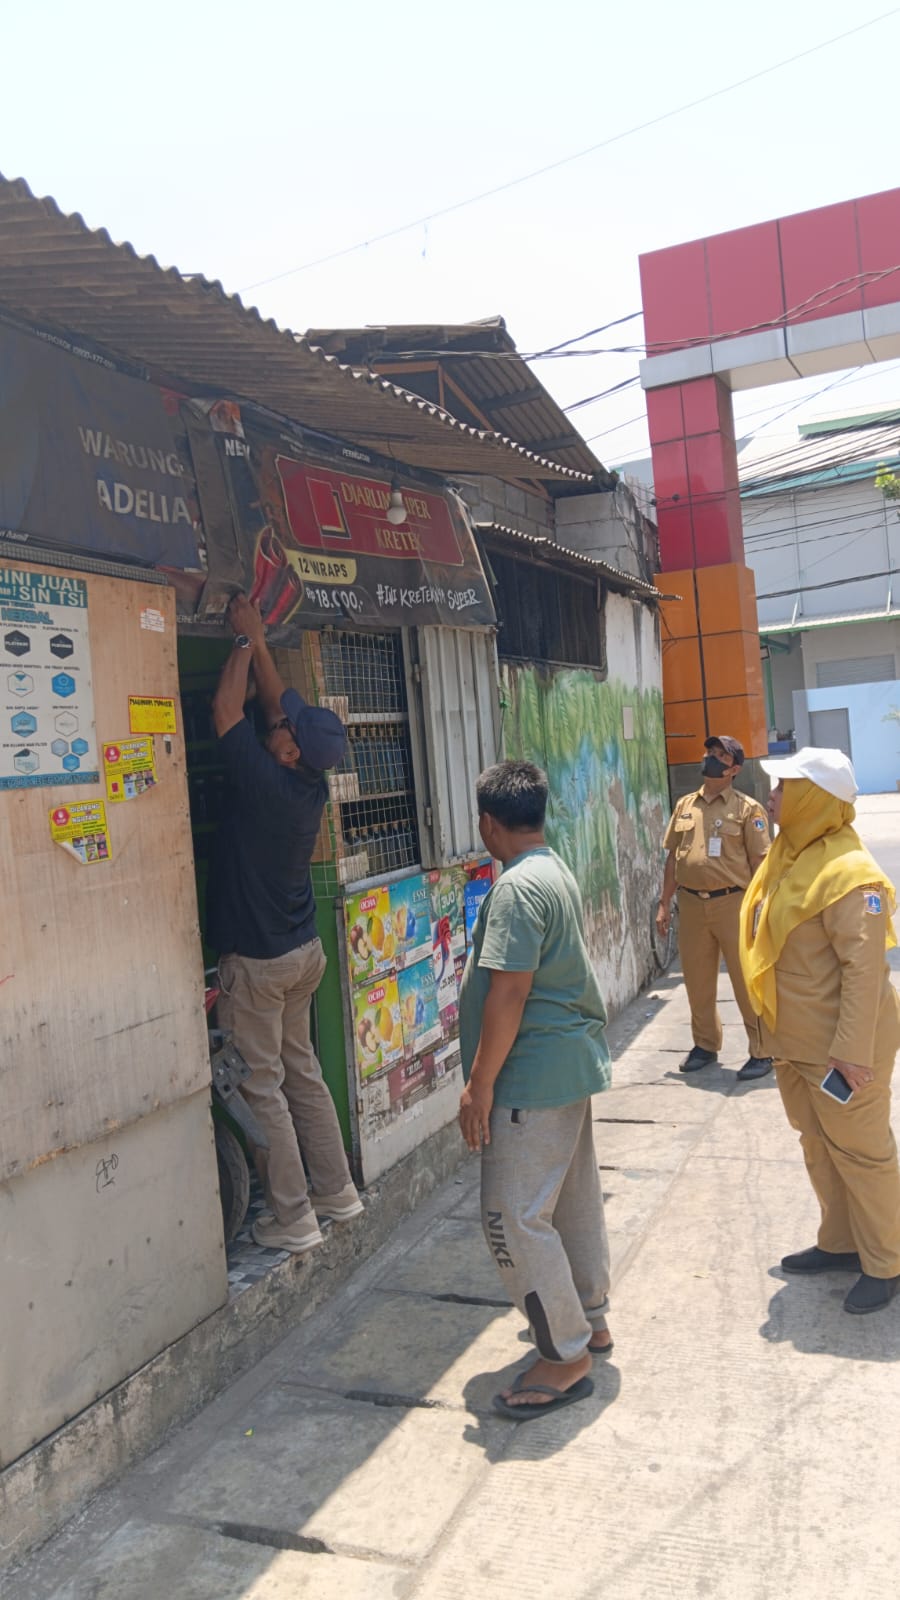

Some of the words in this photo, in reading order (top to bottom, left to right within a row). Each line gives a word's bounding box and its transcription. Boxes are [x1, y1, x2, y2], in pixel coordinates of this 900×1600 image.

[78, 426, 184, 477] WARUNG
[97, 479, 193, 525] ADELIA
[375, 527, 424, 552] KRETEK
[298, 557, 311, 573] 12
[310, 560, 348, 578] WRAPS
[0, 568, 31, 586] INI
[37, 575, 83, 593] JUAL
[19, 586, 51, 603] SIN
[447, 588, 482, 610] SUPER
[487, 1211, 515, 1268] NIKE
